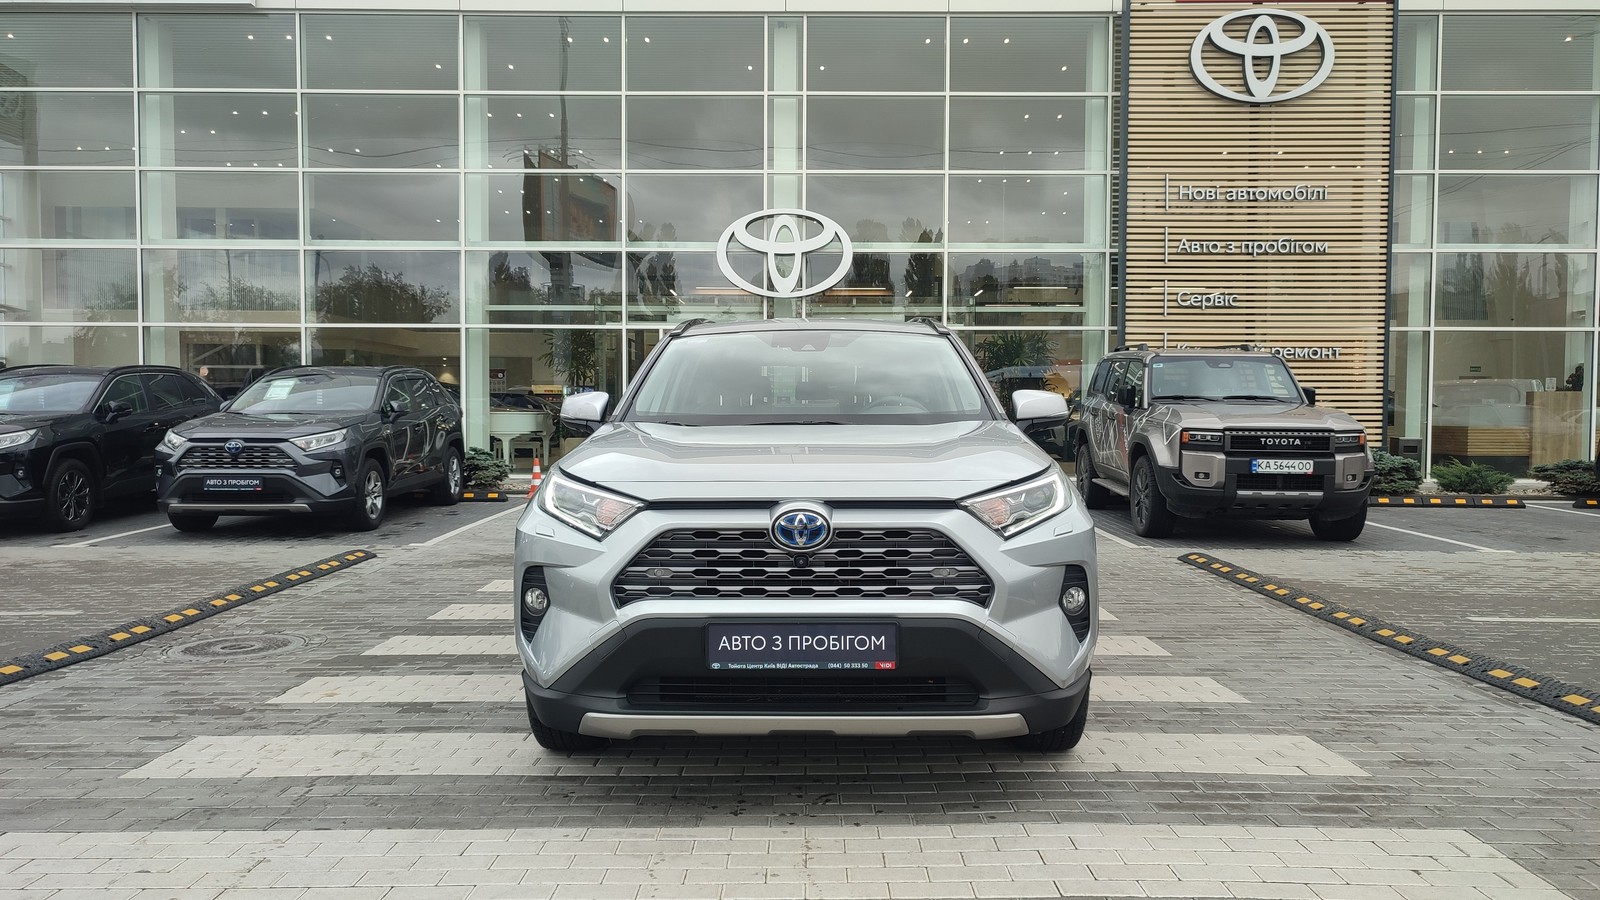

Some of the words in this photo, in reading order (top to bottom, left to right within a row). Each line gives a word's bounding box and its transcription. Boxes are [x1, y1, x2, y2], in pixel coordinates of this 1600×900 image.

[1179, 184, 1221, 200] Нові
[1226, 184, 1329, 201] автомобілі
[1177, 239, 1221, 253] Авто
[1225, 241, 1236, 253] з
[1241, 238, 1329, 257] пробігом
[1177, 292, 1240, 310] Сервіс
[1257, 461, 1271, 470] KA
[1273, 461, 1296, 471] 5644
[718, 635, 767, 650] АВТО
[771, 635, 783, 650] З
[788, 635, 886, 650] ПРОБІГОМ
